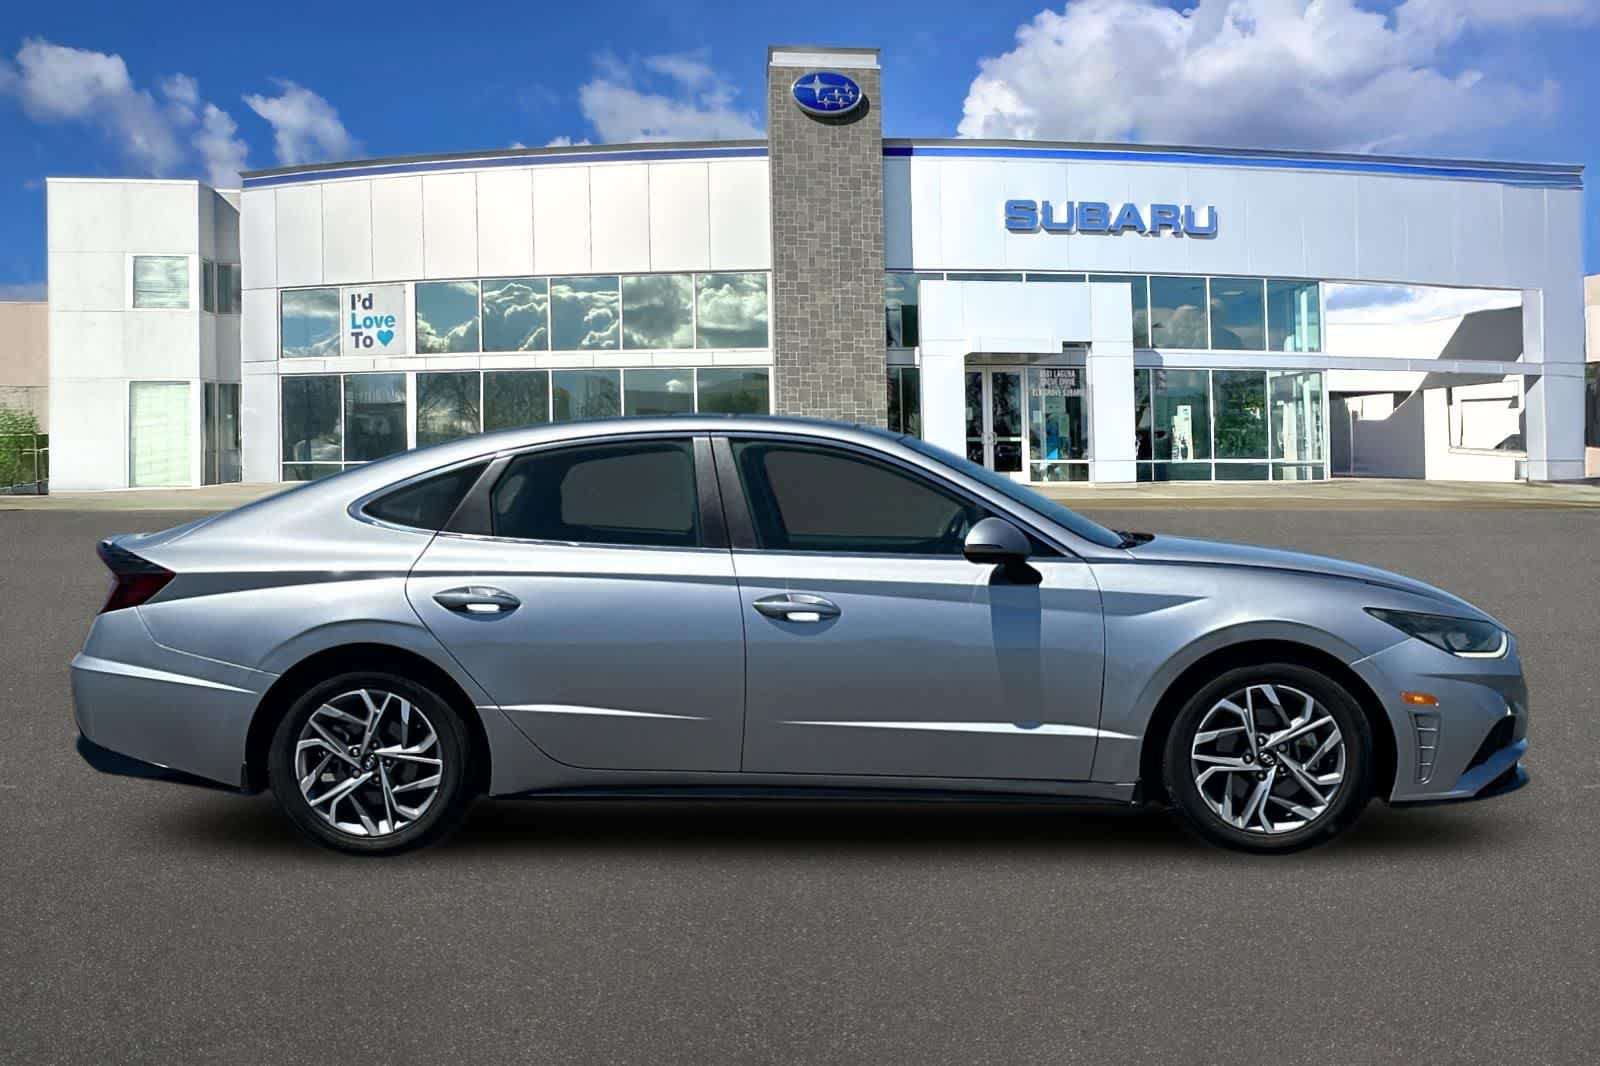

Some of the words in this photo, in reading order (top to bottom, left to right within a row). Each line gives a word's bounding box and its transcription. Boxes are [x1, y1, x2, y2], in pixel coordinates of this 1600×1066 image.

[1005, 199, 1217, 237] SUBARU
[351, 293, 373, 310] I'd
[351, 312, 396, 329] Love
[351, 332, 374, 348] To
